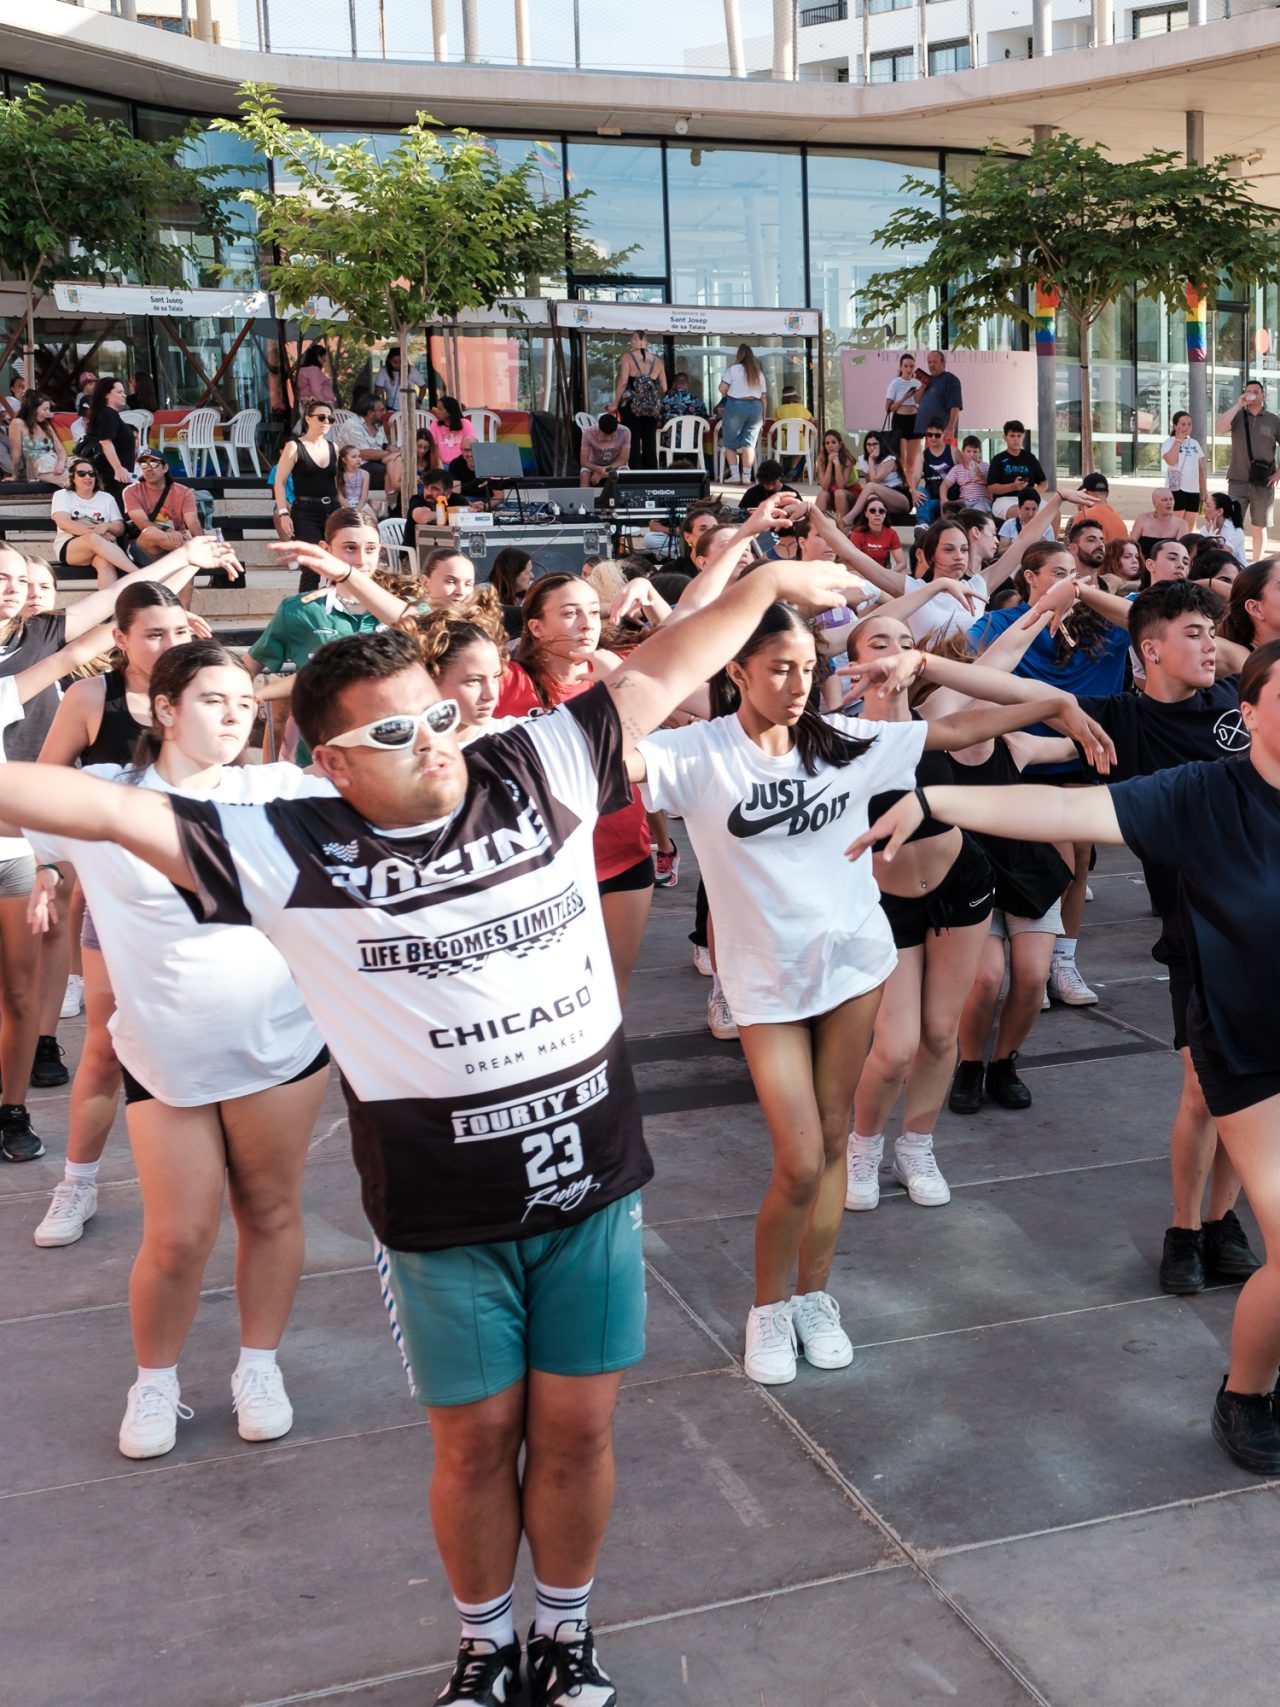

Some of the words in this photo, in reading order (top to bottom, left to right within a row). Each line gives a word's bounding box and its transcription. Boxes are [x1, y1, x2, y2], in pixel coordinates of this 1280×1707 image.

[150, 295, 164, 303] Sant
[166, 297, 184, 305] Josep
[745, 778, 807, 811] JUST
[361, 942, 401, 968] LIFE
[406, 923, 509, 963] BECOMES
[513, 886, 584, 939] LIMITLESS
[428, 985, 592, 1049] CHICAGO
[465, 1052, 525, 1075] DREAM
[537, 1029, 586, 1055] MAKER
[451, 1091, 567, 1137] FOURTY
[575, 1069, 609, 1105] SIX
[520, 1121, 585, 1188] 23
[520, 1174, 601, 1224] Racing
